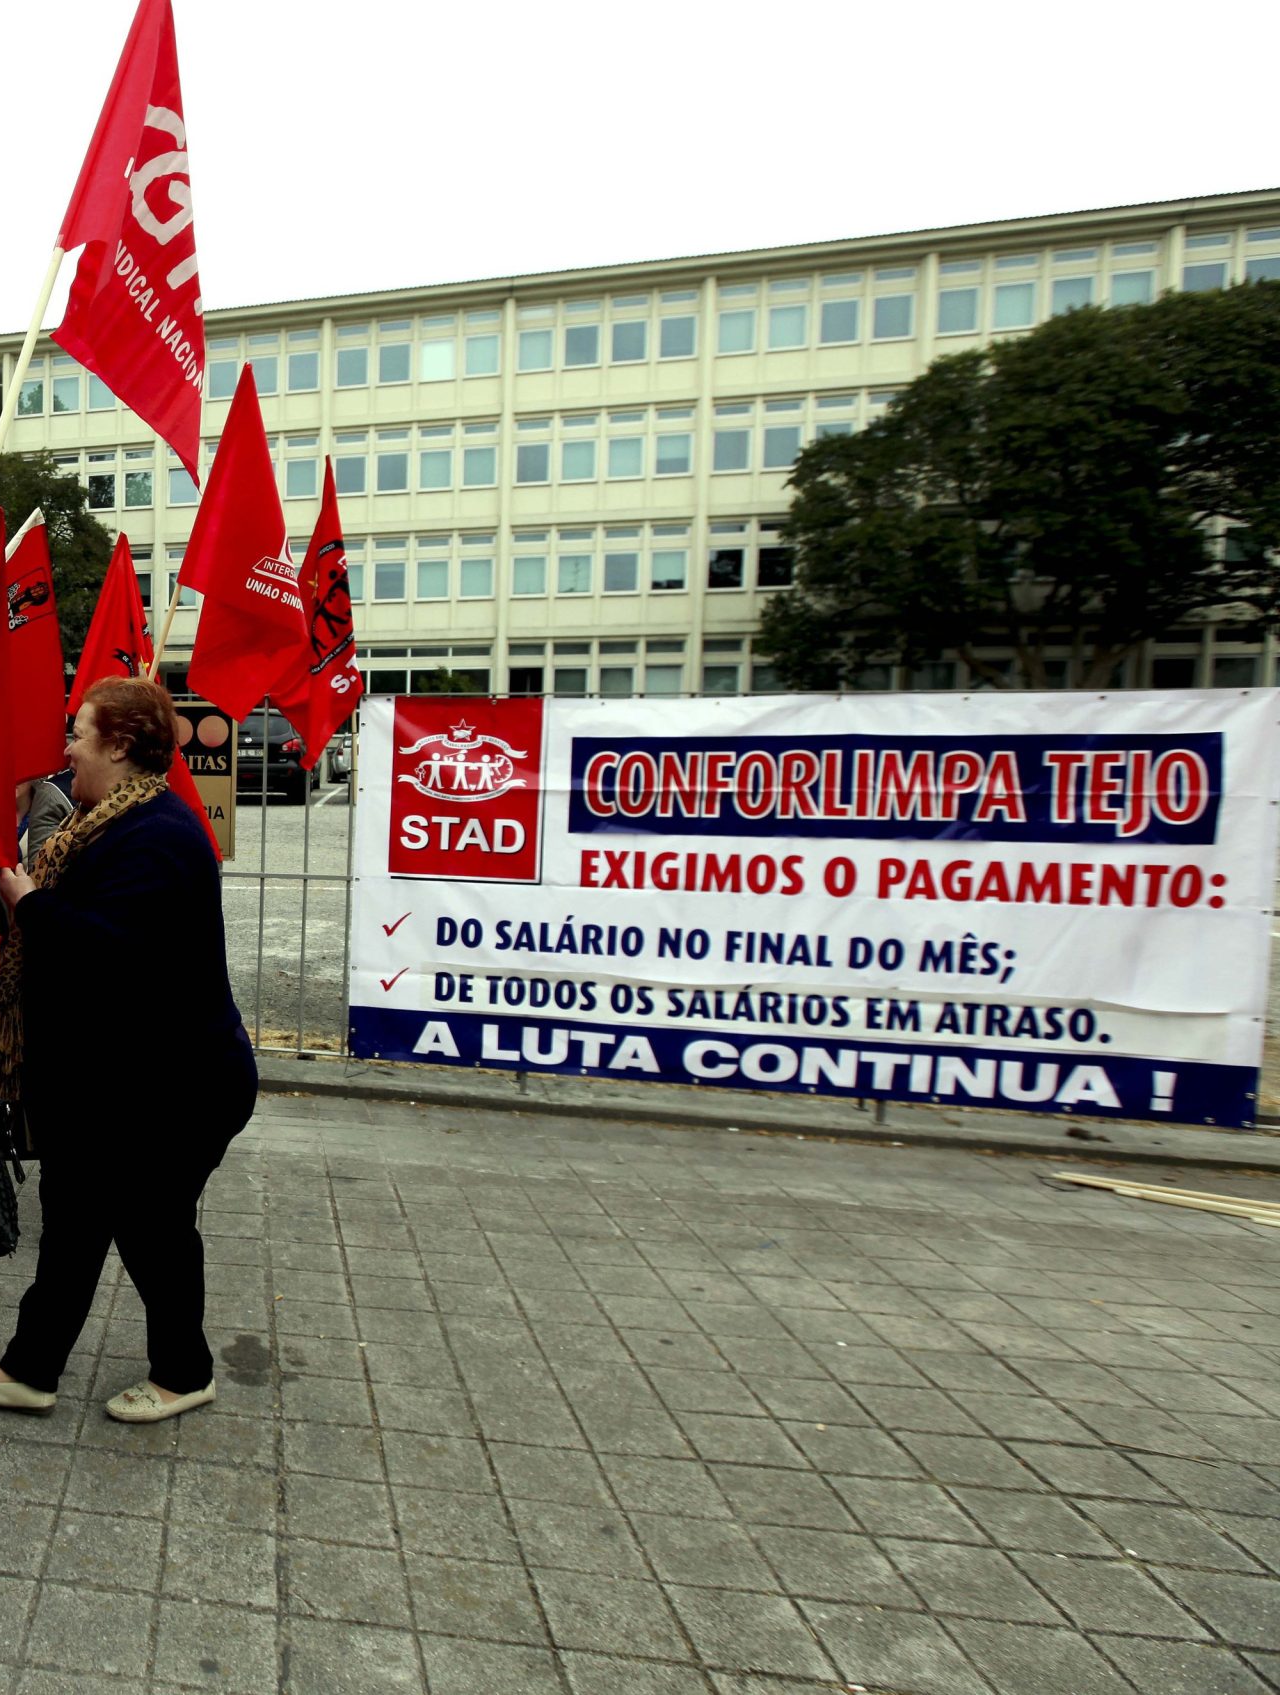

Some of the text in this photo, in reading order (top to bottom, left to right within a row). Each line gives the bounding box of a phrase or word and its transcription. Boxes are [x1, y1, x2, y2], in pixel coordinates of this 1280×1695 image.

[245, 577, 280, 600] UNIÃO
[263, 560, 298, 580] INTERS
[186, 754, 227, 771] ITAS
[583, 749, 1209, 837] CONFORLIMPA TEJO
[400, 814, 526, 854] STAD
[580, 849, 1227, 909] EXIGIMOS O PAGAMENTO:
[436, 915, 1017, 983] DO SALÁRIO NO FINAL DO MÊS;
[434, 971, 1112, 1044] DE TODOS OS SALÁRIOS EM ATRASO.
[412, 1020, 1177, 1112] A LUTA CONTINUA !
